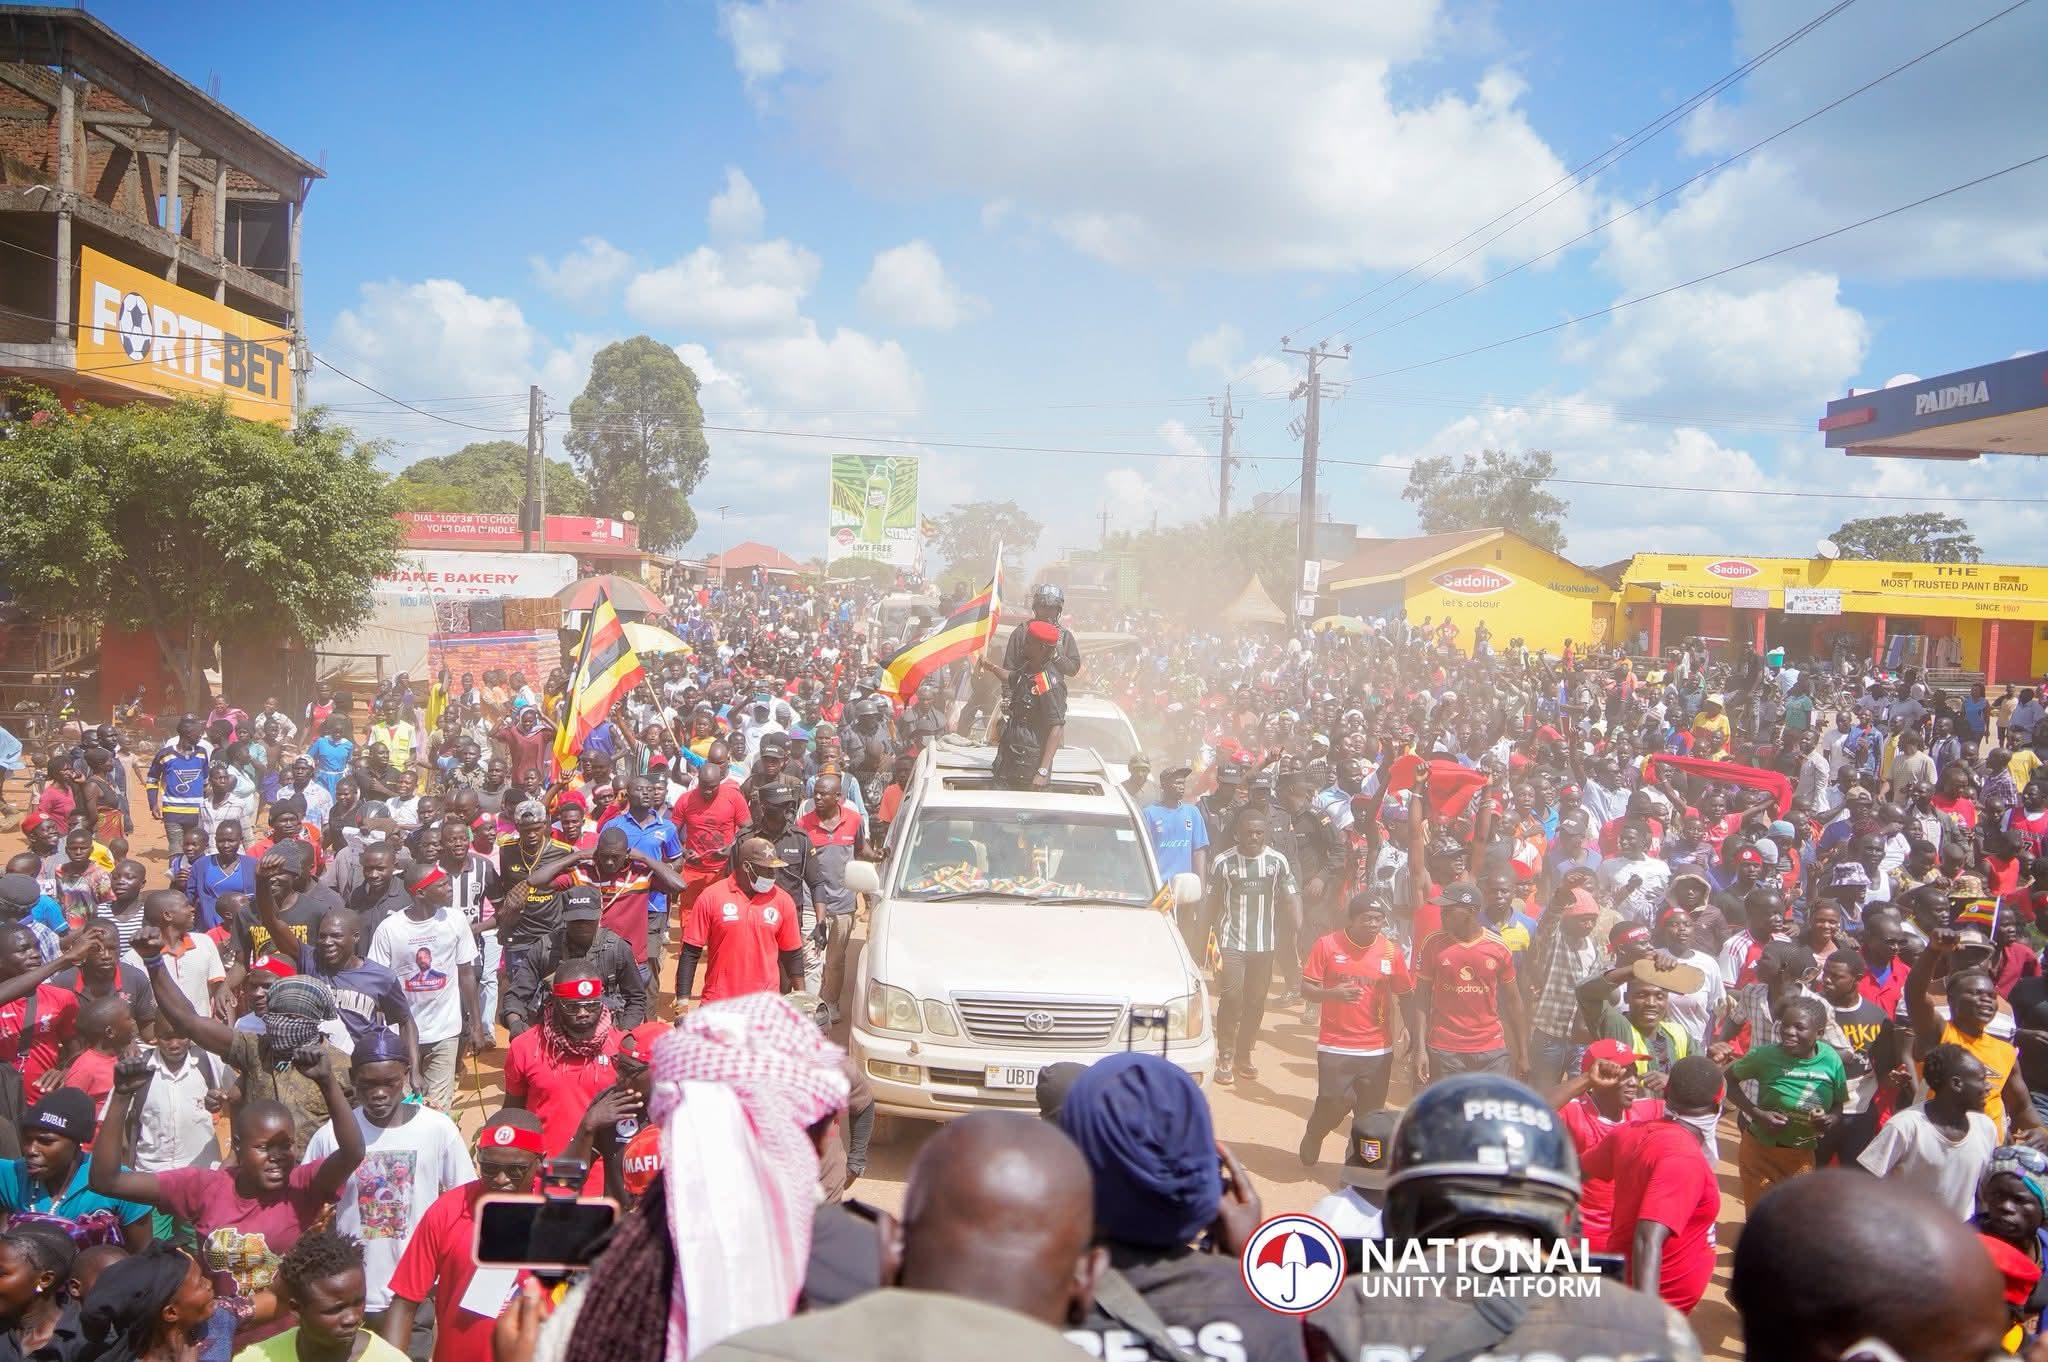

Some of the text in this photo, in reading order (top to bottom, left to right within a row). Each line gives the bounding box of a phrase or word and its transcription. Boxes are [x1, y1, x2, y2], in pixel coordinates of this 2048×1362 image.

[1915, 380, 1990, 416] PAIDHA
[413, 513, 433, 522] DIAL
[476, 515, 488, 524] TO
[489, 515, 518, 525] CHOO
[454, 525, 478, 534] DATA
[1713, 565, 1752, 577] Sadolin
[1934, 566, 1979, 577] THE
[444, 572, 521, 585] BAKERY
[1442, 574, 1501, 588] Sadolin
[1880, 578, 2029, 592] MOST TRUSTED PAINT BRAND
[1672, 588, 1695, 599] let's
[1696, 589, 1732, 600] colour
[1442, 599, 1501, 609] let's colour
[1975, 602, 2001, 612] SINCE
[527, 894, 553, 905] dragon
[568, 896, 591, 905] POLICE
[1006, 1069, 1035, 1086] UBD
[40, 1112, 68, 1129] DUBAI
[1462, 1100, 1553, 1132] PRESS
